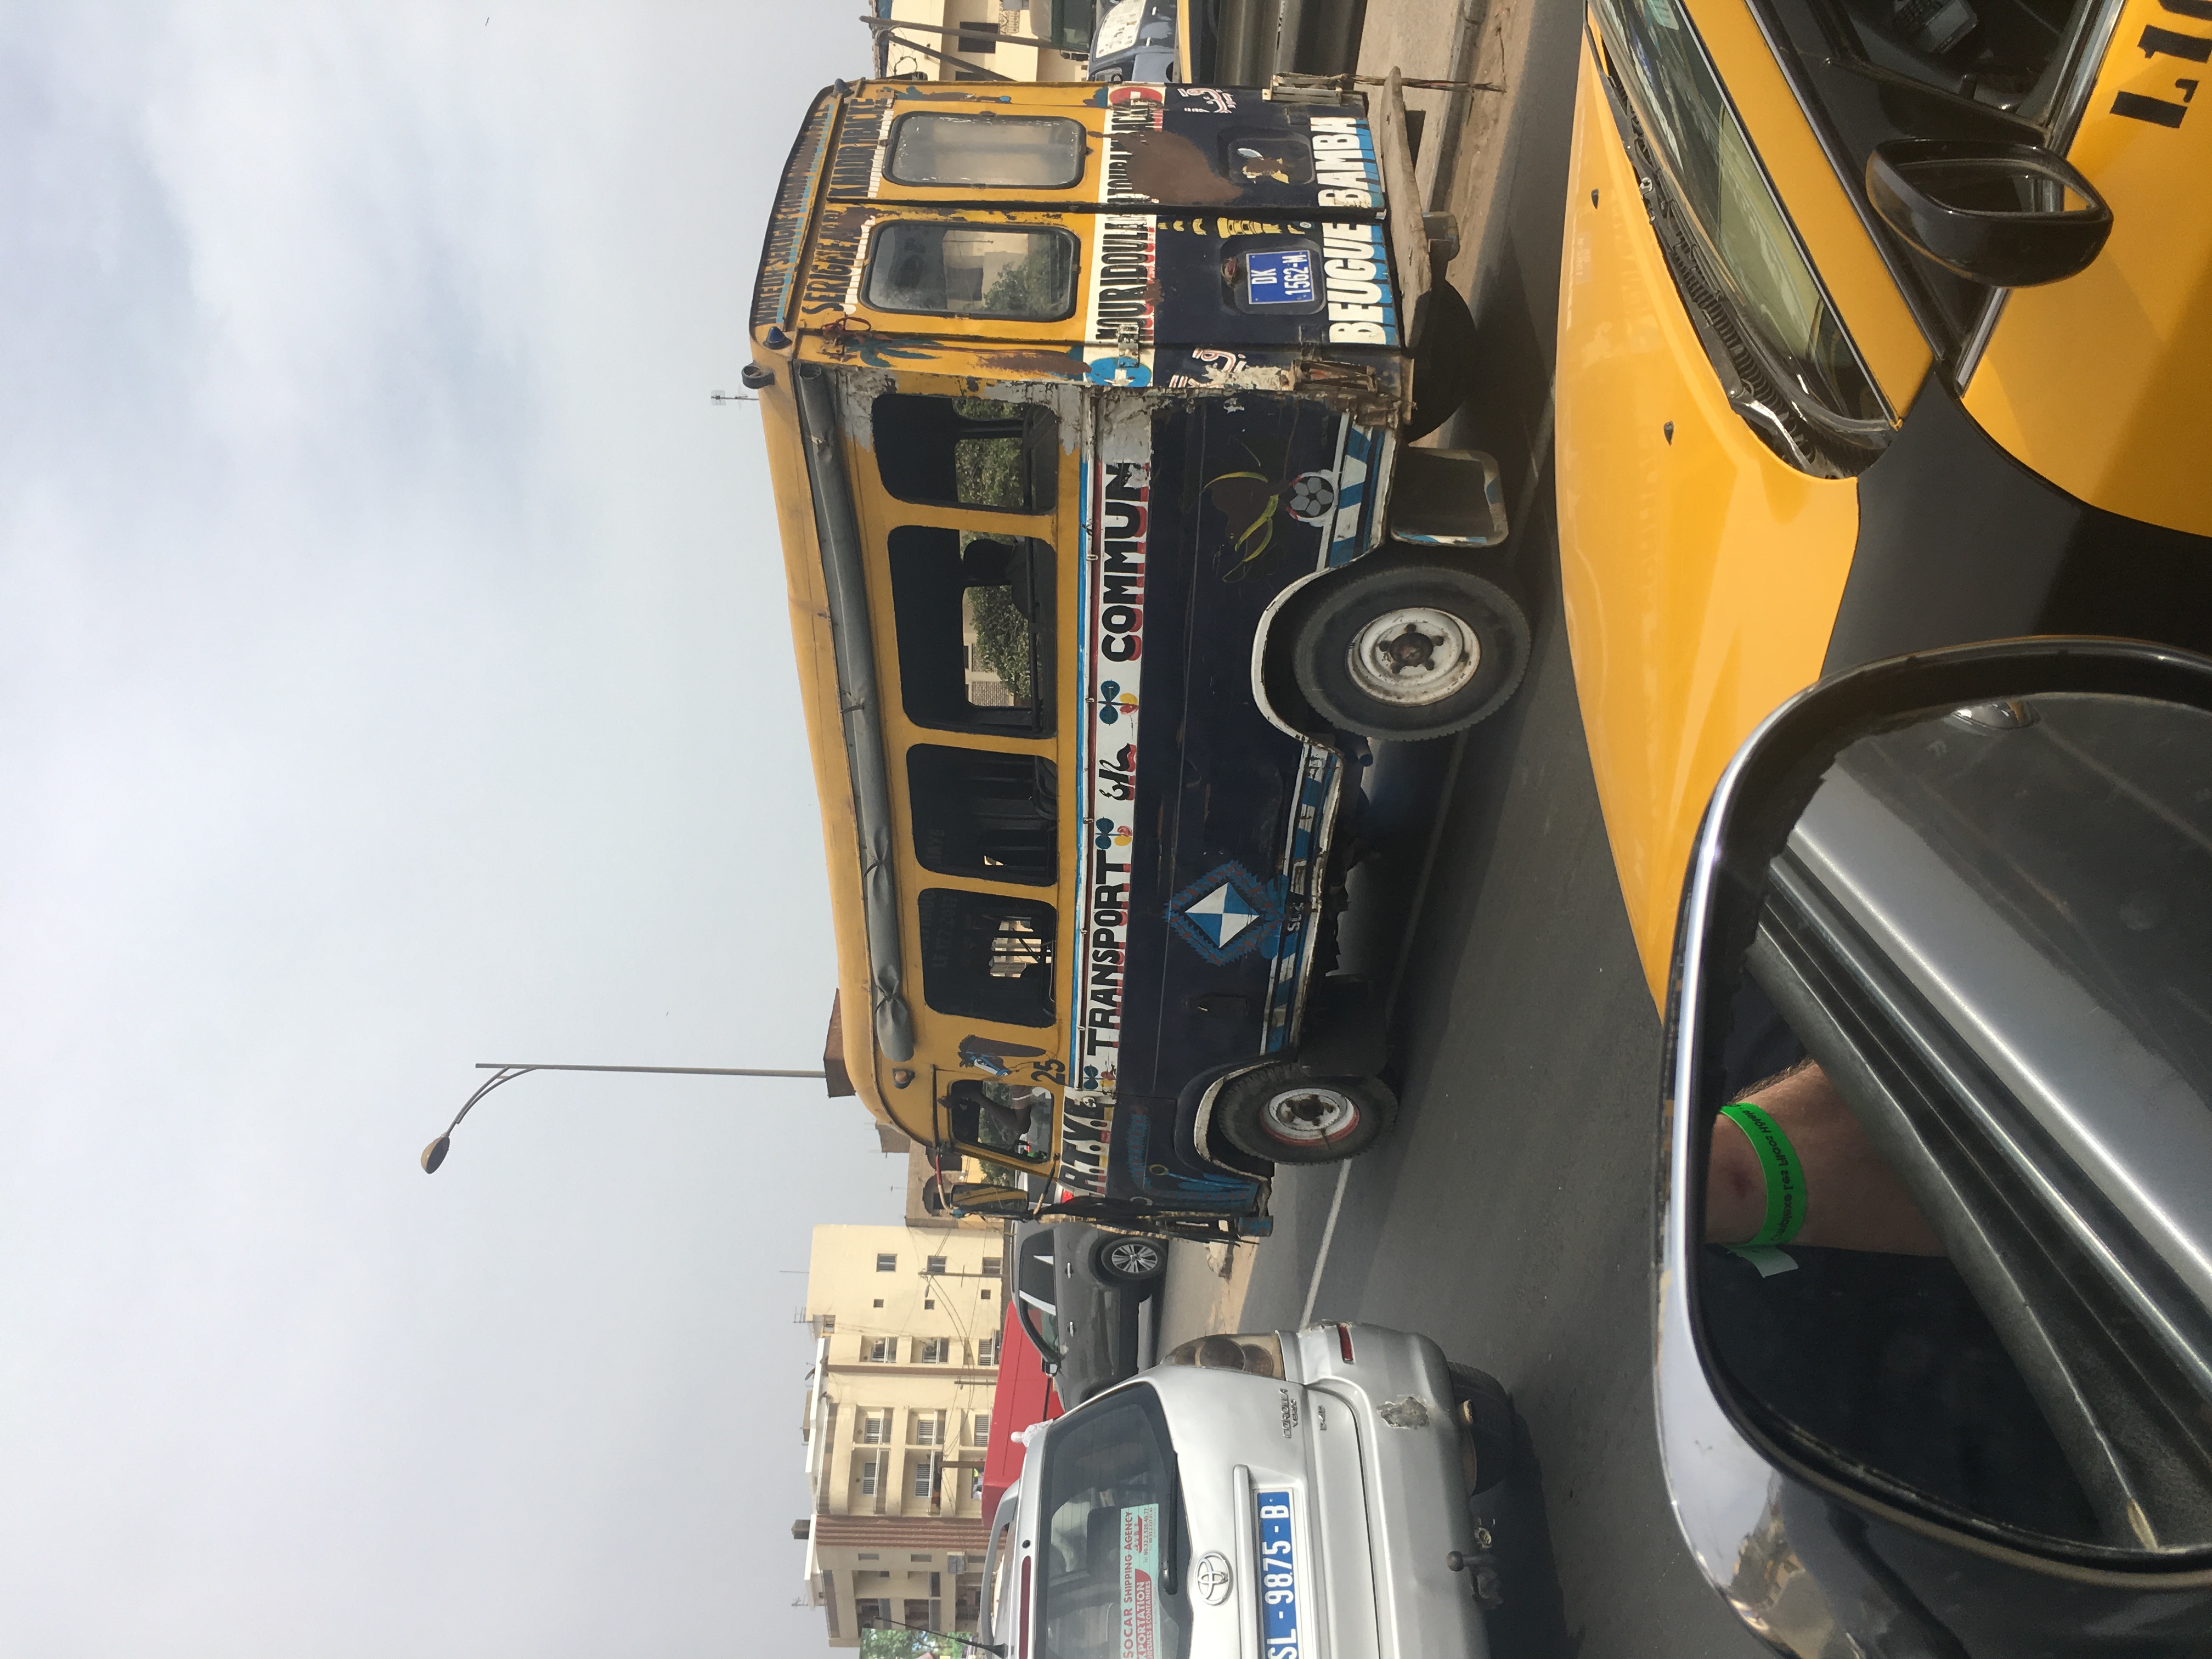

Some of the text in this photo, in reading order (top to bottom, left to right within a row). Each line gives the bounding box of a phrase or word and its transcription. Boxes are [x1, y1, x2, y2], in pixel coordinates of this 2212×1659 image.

[1251, 268, 1278, 284] DK
[1282, 254, 1311, 295] 1562-M
[1310, 117, 1387, 345] BEUGUE BAMBA
[1101, 461, 1141, 662] COMMUN
[1087, 849, 1125, 1056] TRANSPORT
[1031, 1058, 1065, 1086] 25
[1279, 1387, 1292, 1438] COROLLA
[1123, 1511, 1134, 1658] SOCAR SHIPPING AGENCY
